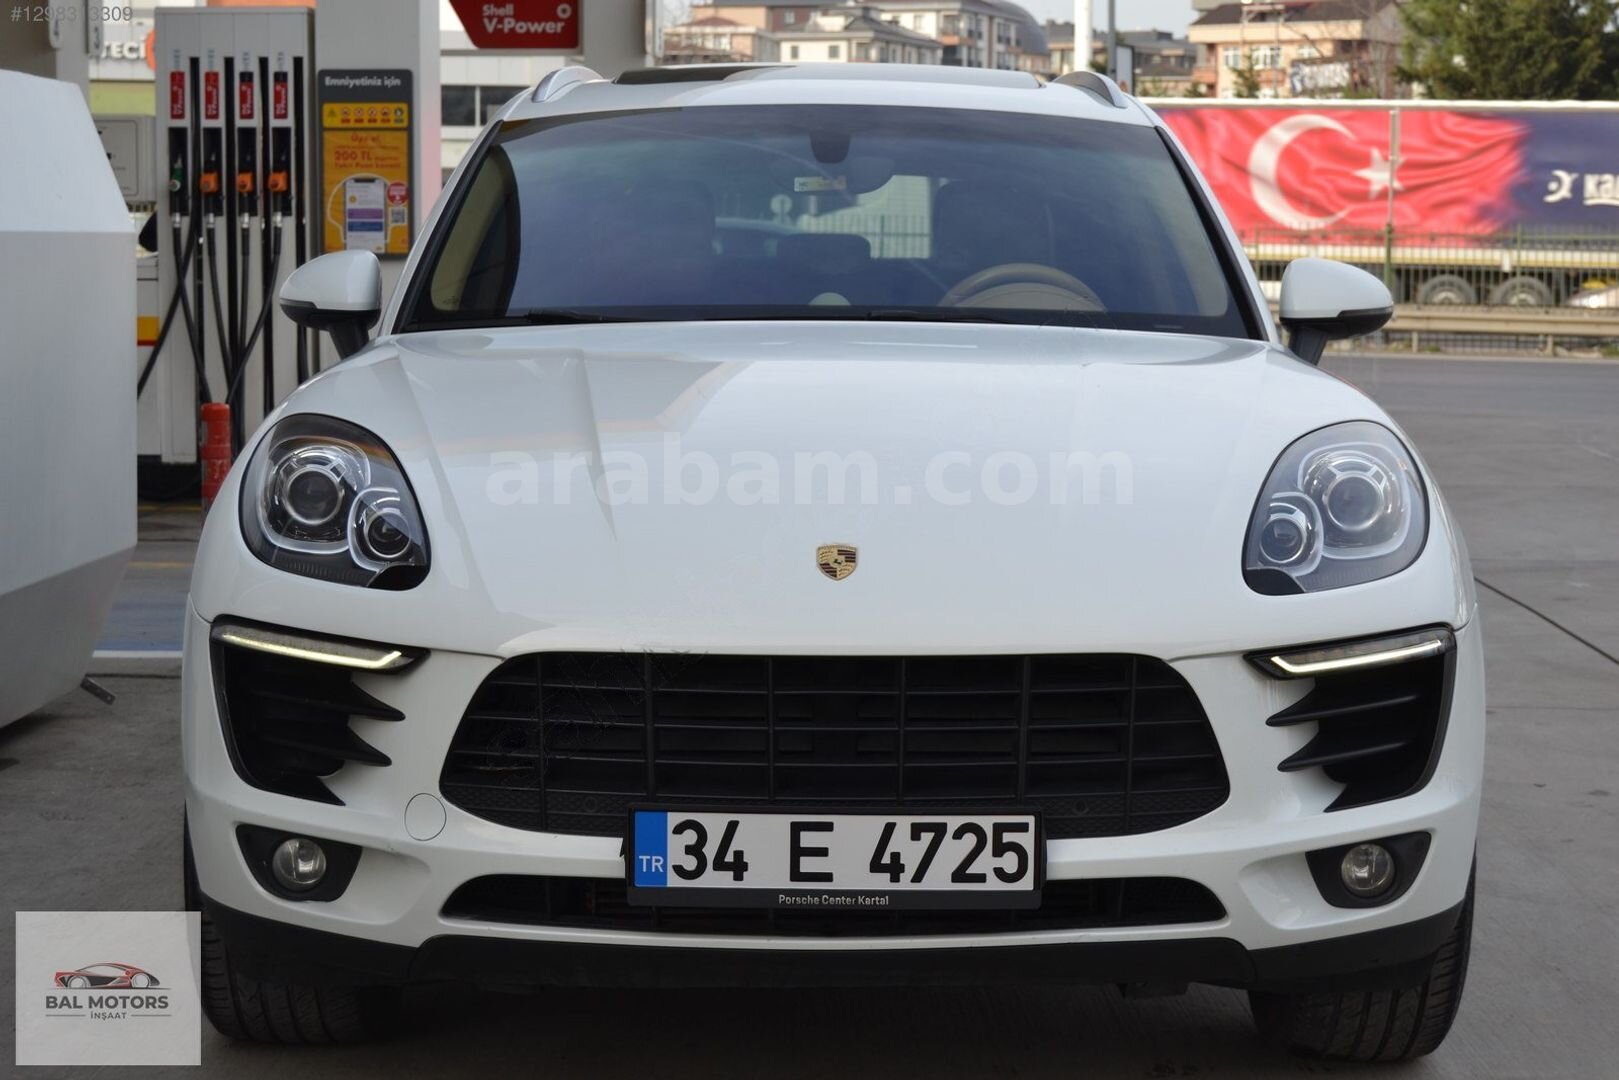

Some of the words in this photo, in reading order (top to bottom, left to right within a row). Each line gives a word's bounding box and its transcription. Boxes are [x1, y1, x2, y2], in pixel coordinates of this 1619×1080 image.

[482, 4, 514, 17] Shell
[483, 17, 565, 34] V-Power
[325, 76, 382, 89] Emniyetiniz
[384, 76, 401, 89] için
[671, 819, 749, 882] 34
[789, 821, 835, 883] E
[869, 821, 1030, 884] 4725
[639, 856, 664, 873] TR
[778, 894, 820, 906] Porsche
[821, 894, 856, 906] Center
[858, 895, 889, 906] Kartal
